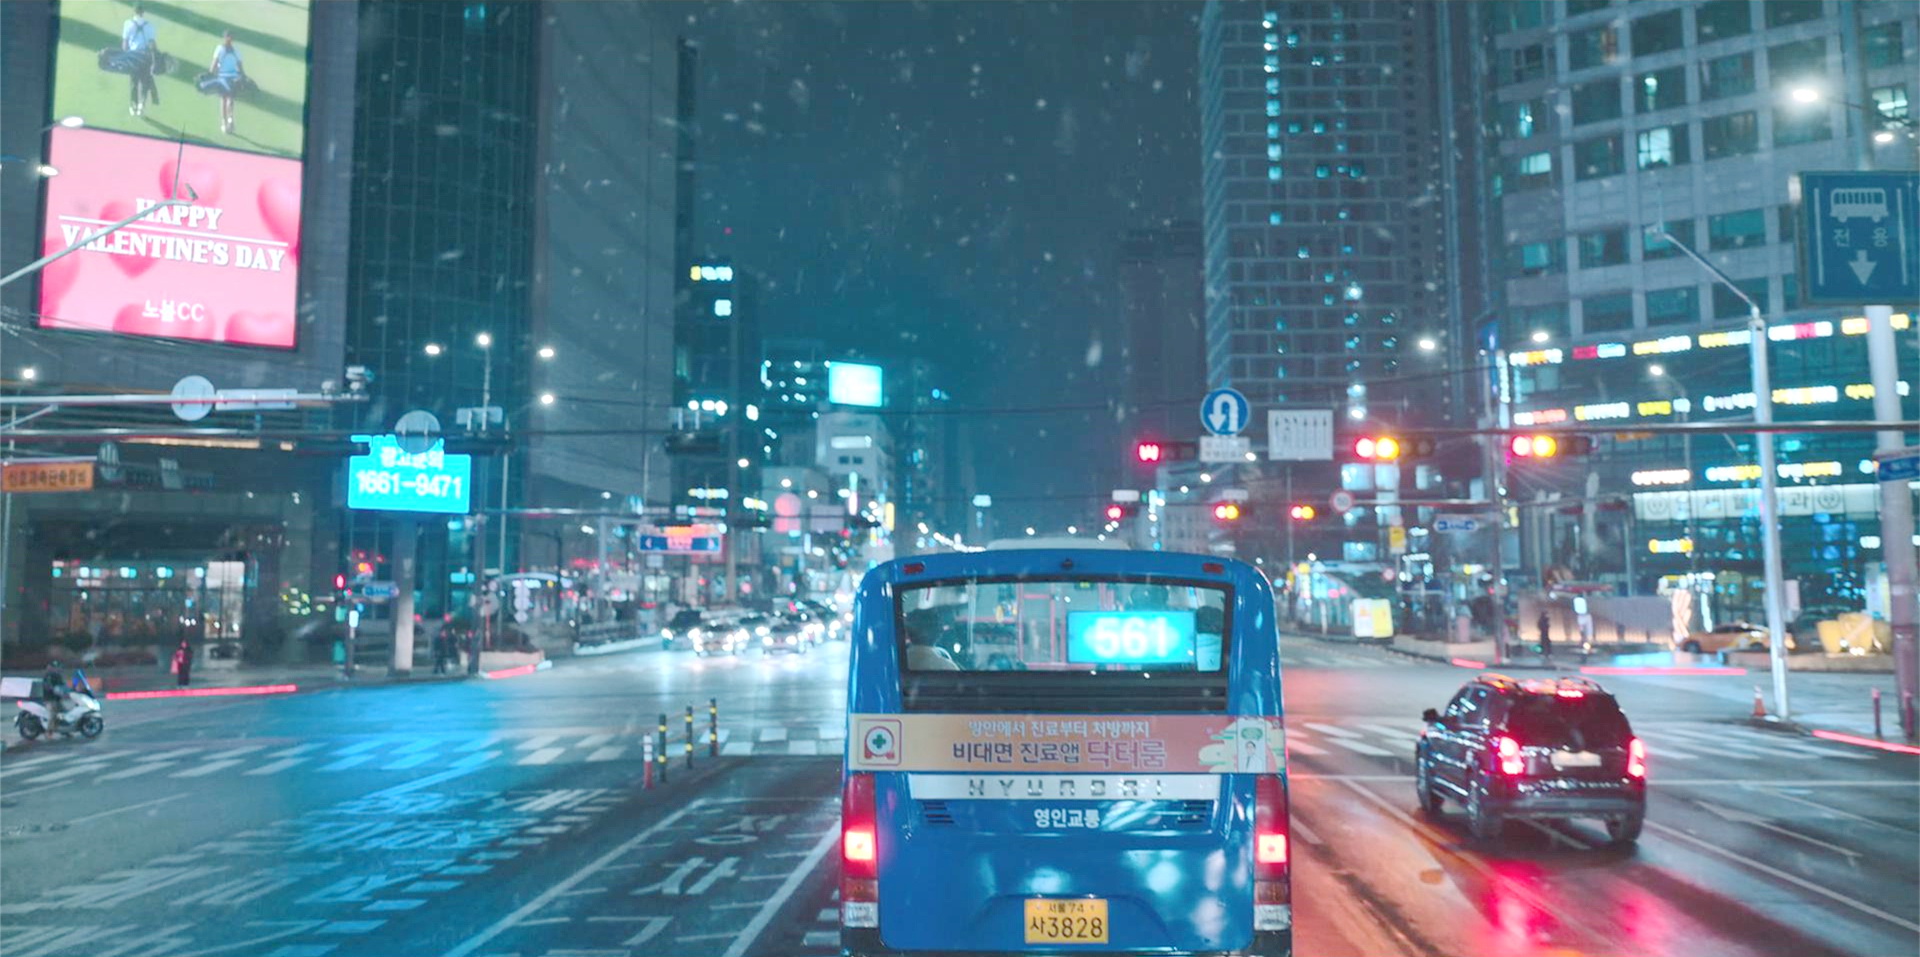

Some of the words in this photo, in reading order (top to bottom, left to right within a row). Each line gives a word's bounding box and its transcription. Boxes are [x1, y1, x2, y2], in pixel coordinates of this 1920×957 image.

[136, 198, 223, 230] HAPPY
[61, 224, 229, 267] VALENTINE'S
[234, 244, 285, 272] DAY
[356, 470, 462, 499] 1661-9471
[1095, 617, 1168, 658] 561
[968, 720, 1026, 738] 방안에서
[1030, 720, 1088, 737] 진료부터
[1092, 720, 1150, 739] 처방까지
[952, 742, 1013, 763] 비대면
[1020, 742, 1080, 763] 진료앱
[1087, 739, 1166, 769] 닥터룸
[969, 779, 1161, 796] HYUNDAI
[1034, 808, 1100, 829] 영인교통
[1030, 916, 1103, 938] 사3828
